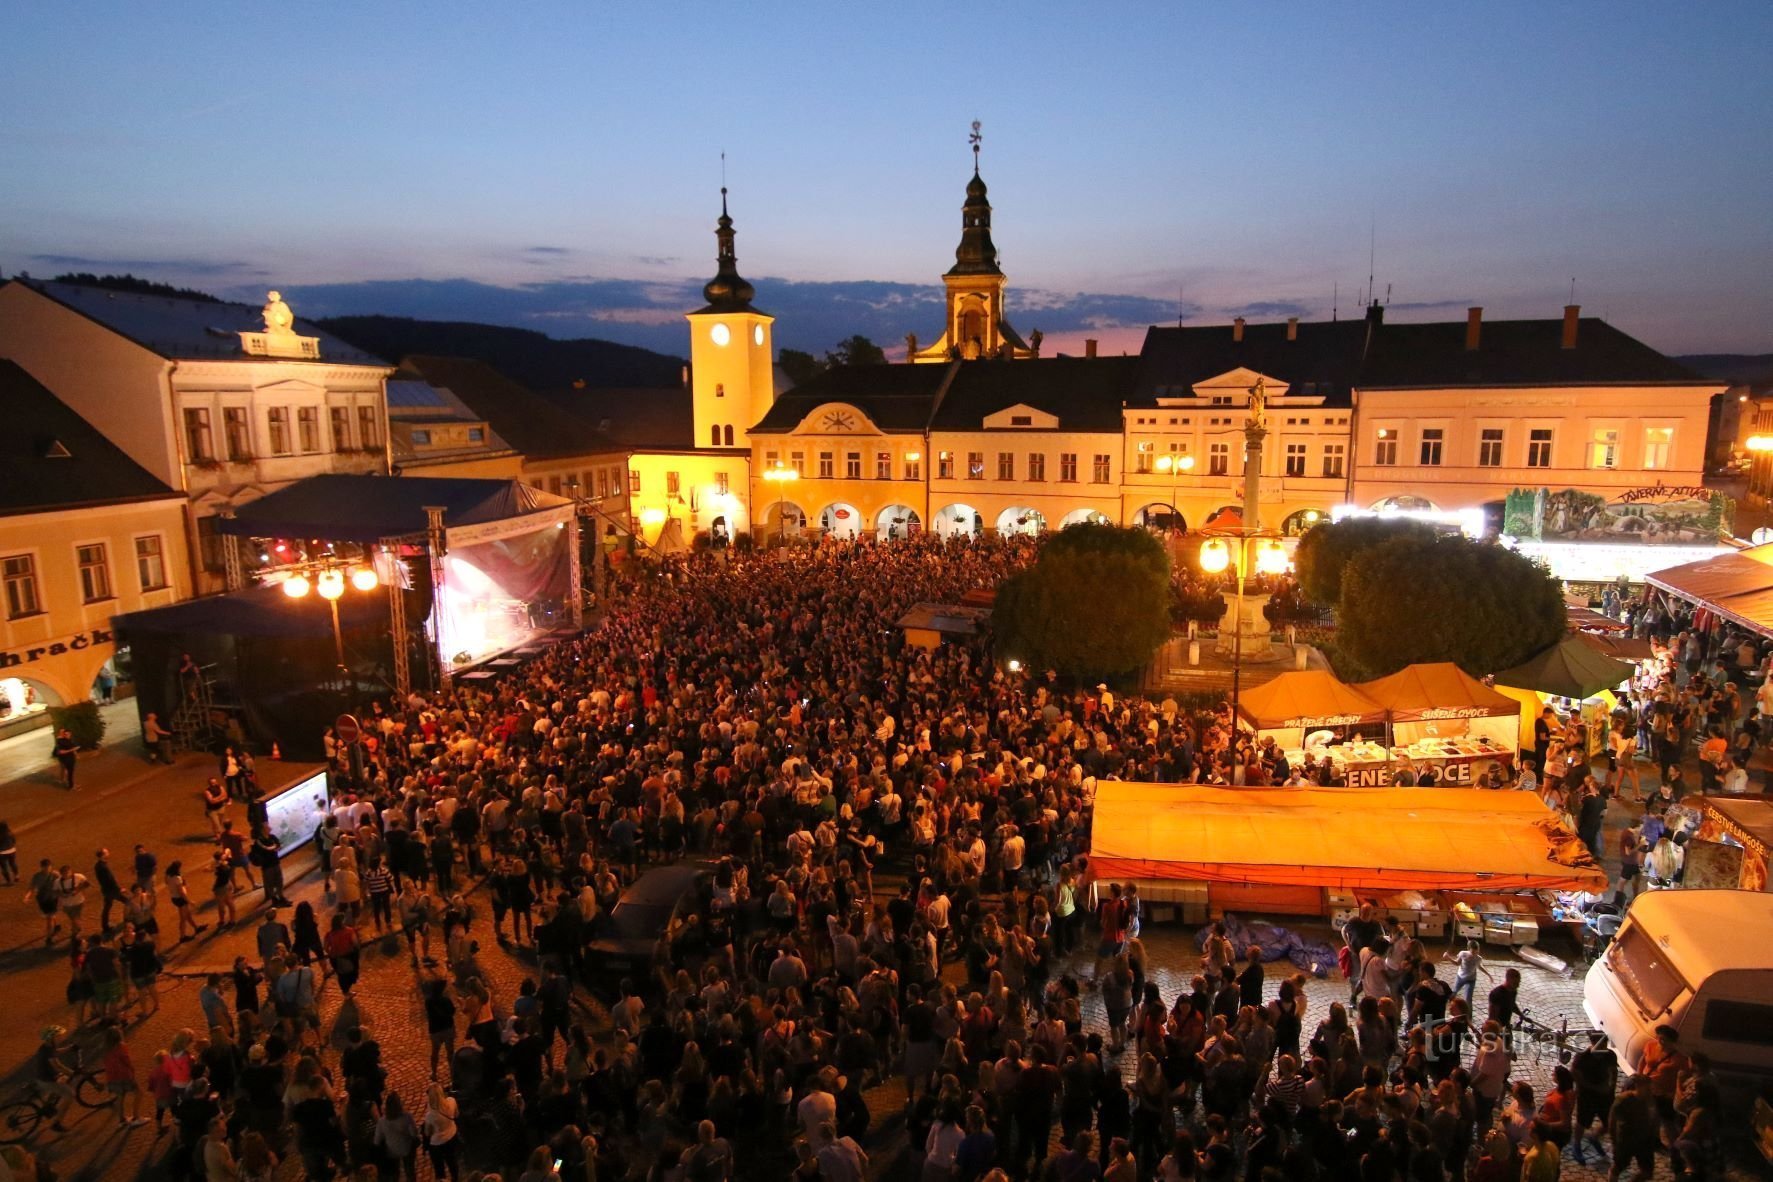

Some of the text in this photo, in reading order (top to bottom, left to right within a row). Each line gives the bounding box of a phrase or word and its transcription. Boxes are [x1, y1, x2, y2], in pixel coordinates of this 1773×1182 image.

[1421, 707, 1489, 720] SUŠENÉ OVOCE
[1284, 714, 1361, 728] PRAŽENÉ OŘECHY
[1708, 805, 1765, 855] ČERSTVÉ LANGOŠE
